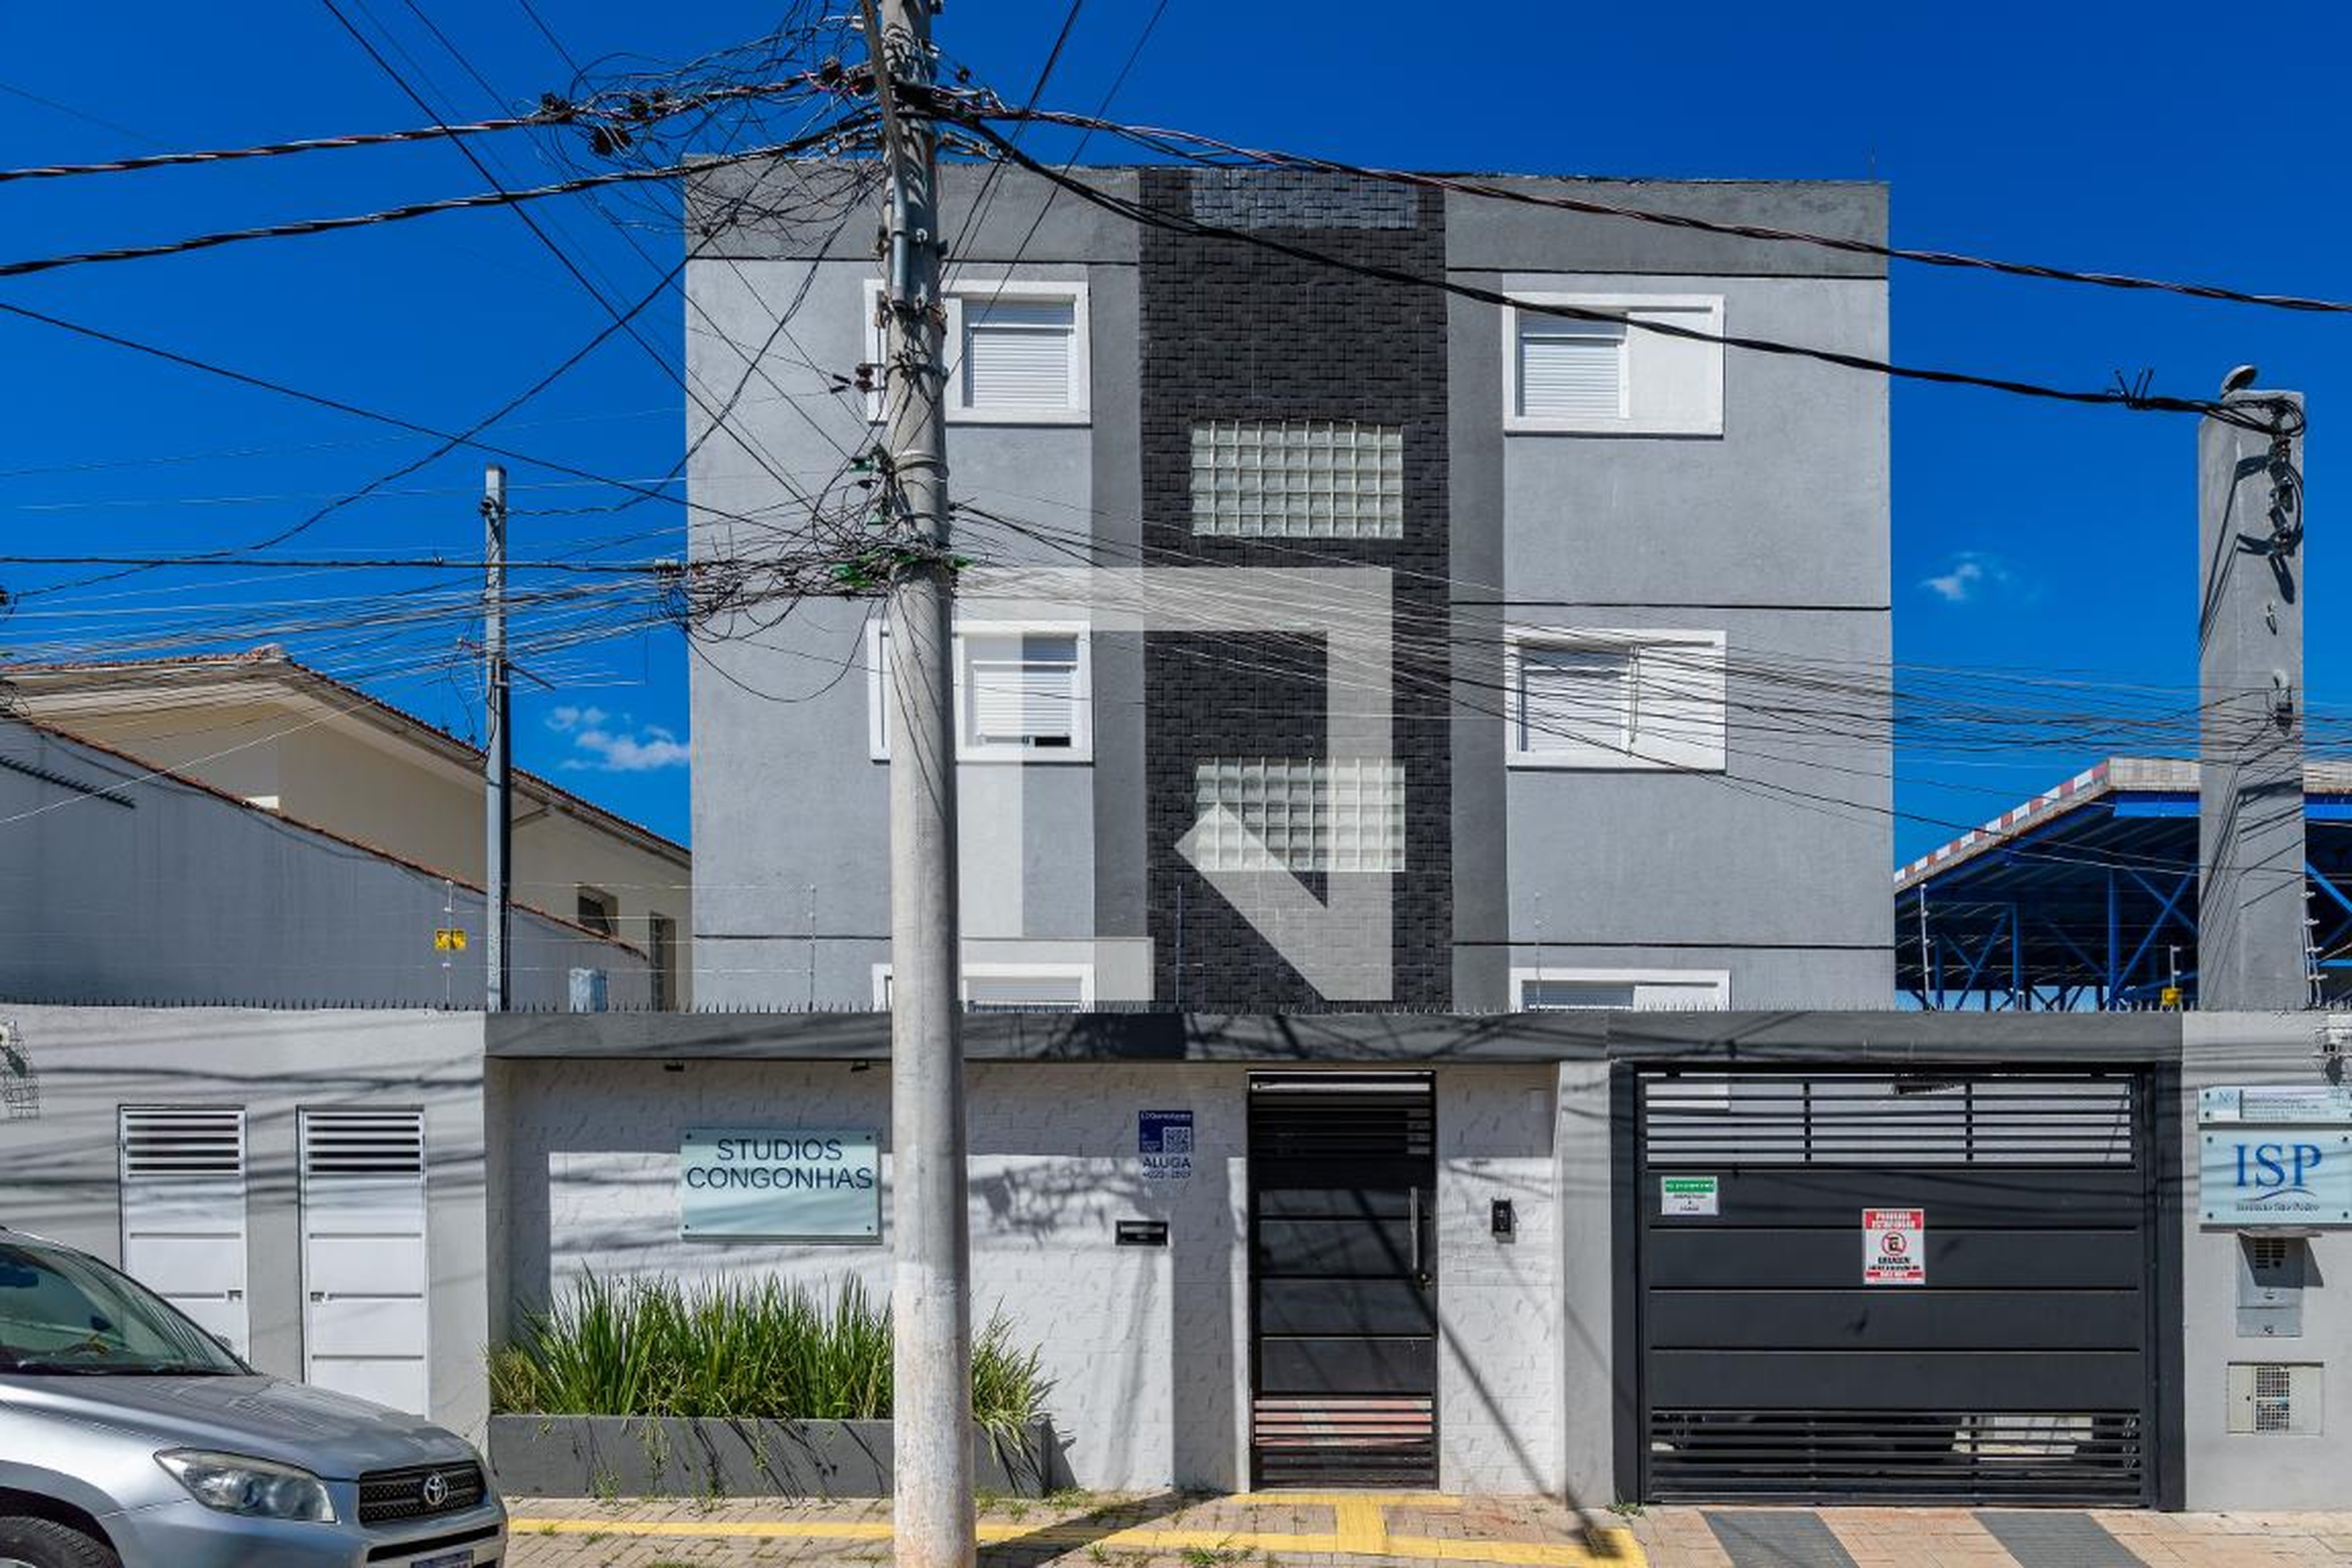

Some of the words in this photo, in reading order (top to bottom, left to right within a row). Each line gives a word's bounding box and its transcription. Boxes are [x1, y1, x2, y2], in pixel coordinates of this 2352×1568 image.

[717, 1138, 842, 1161] STUDIOS
[1143, 1157, 1191, 1169] ALUGA
[2233, 1144, 2322, 1186] ISP
[687, 1167, 873, 1189] CONGONHAS
